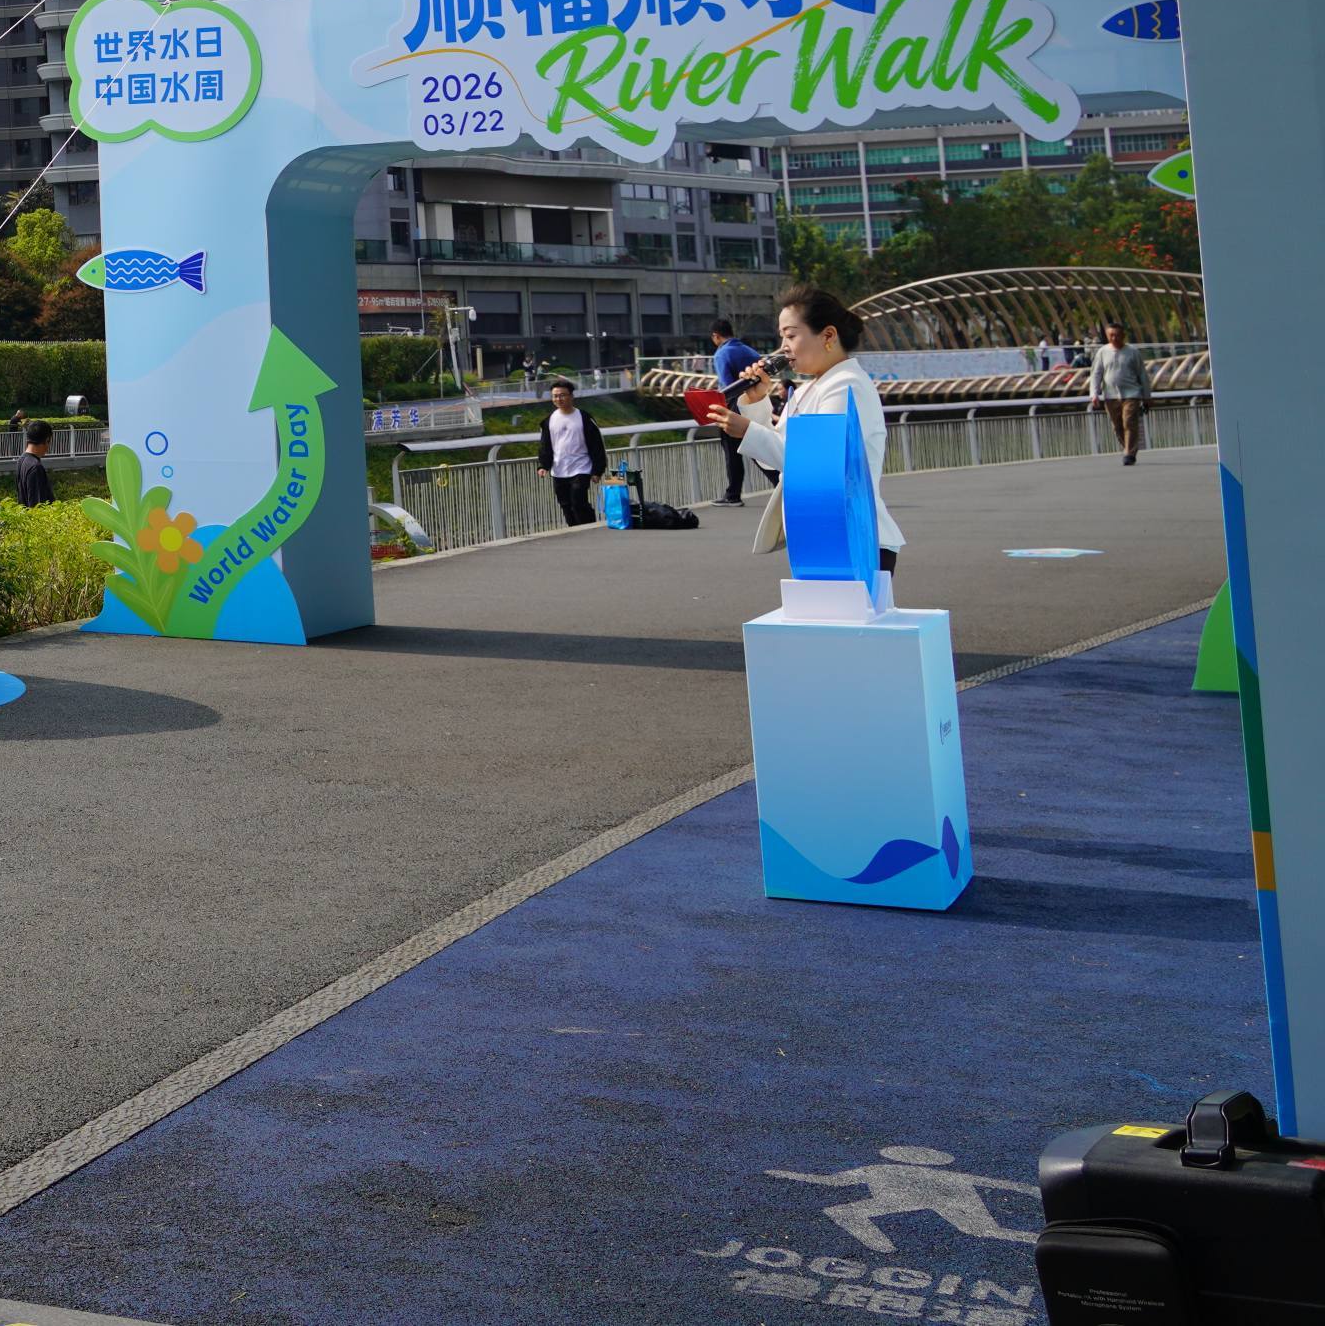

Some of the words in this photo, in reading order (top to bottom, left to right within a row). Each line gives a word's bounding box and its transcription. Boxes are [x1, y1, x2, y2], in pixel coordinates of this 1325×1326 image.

[93, 26, 222, 63] 世界水日
[95, 69, 224, 106] 中国水周
[422, 71, 503, 103] 2026
[536, 24, 781, 146] River
[423, 109, 505, 136] 03/22
[188, 535, 255, 605] World
[250, 467, 307, 543] Water
[285, 403, 310, 458] Day
